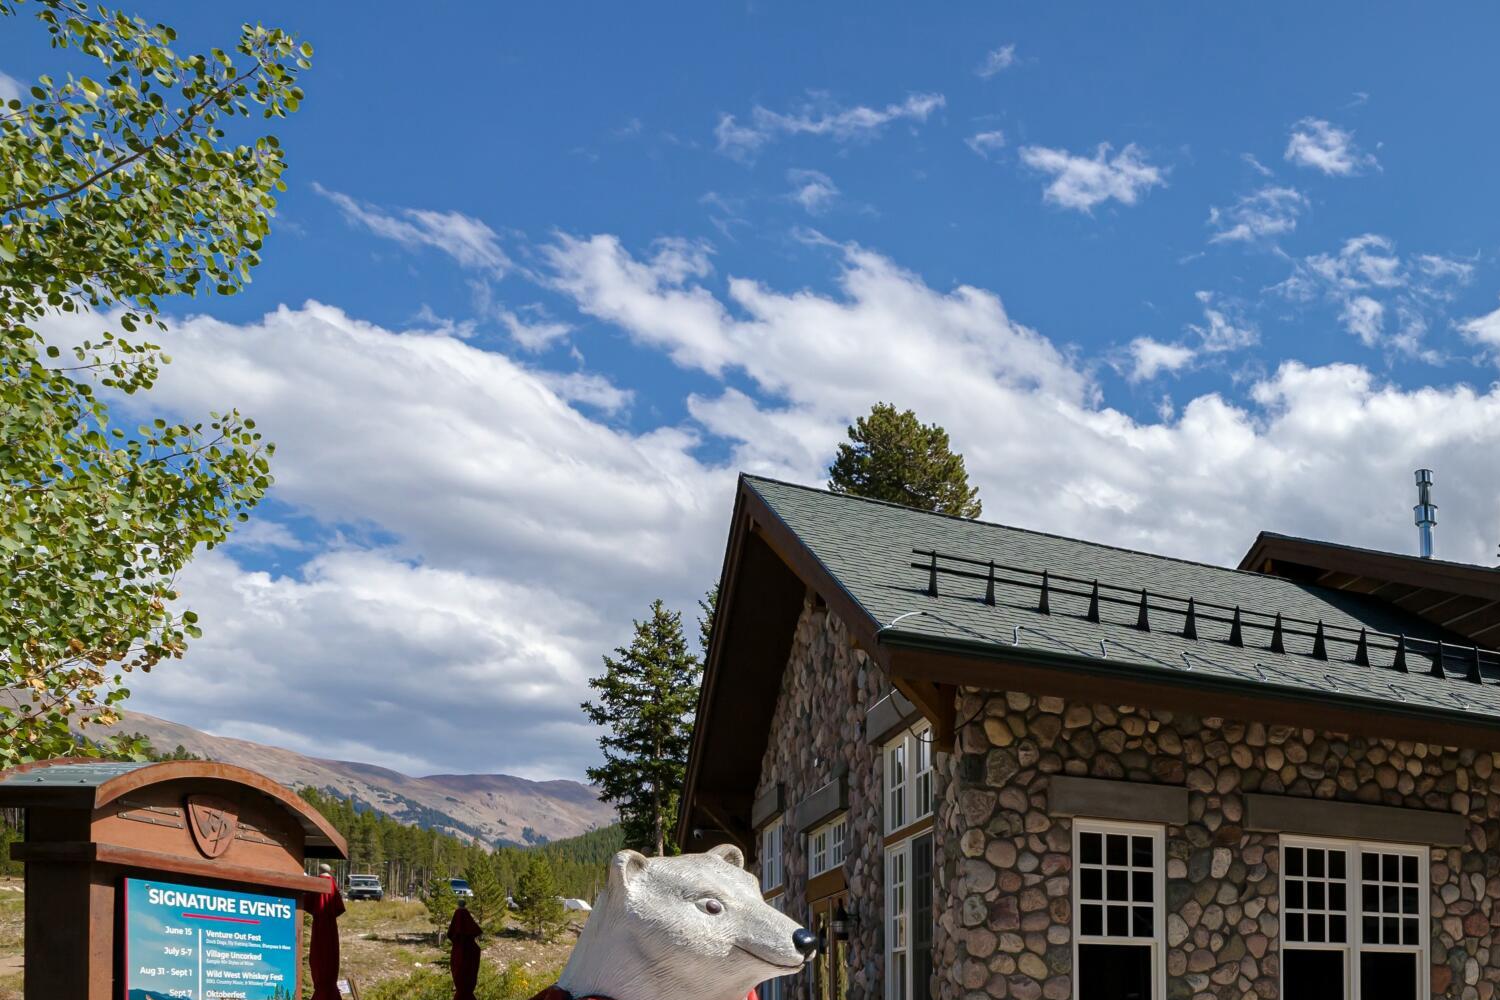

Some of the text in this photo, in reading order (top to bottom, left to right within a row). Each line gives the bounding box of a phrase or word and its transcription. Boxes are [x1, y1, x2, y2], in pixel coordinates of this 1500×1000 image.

[148, 888, 292, 919] SIGNATURE EVENTS
[164, 925, 193, 936] June 15
[205, 929, 262, 942] Venture Out Fest
[163, 946, 193, 957] July 5-7
[205, 949, 262, 961] Village Uncorked
[139, 966, 156, 977] Aug
[156, 967, 165, 975] 31
[170, 968, 188, 978] Sept
[206, 969, 284, 982] Wild West Whiskey Fest
[169, 988, 193, 999] Sept 7
[206, 990, 246, 999] Oktoberfest
